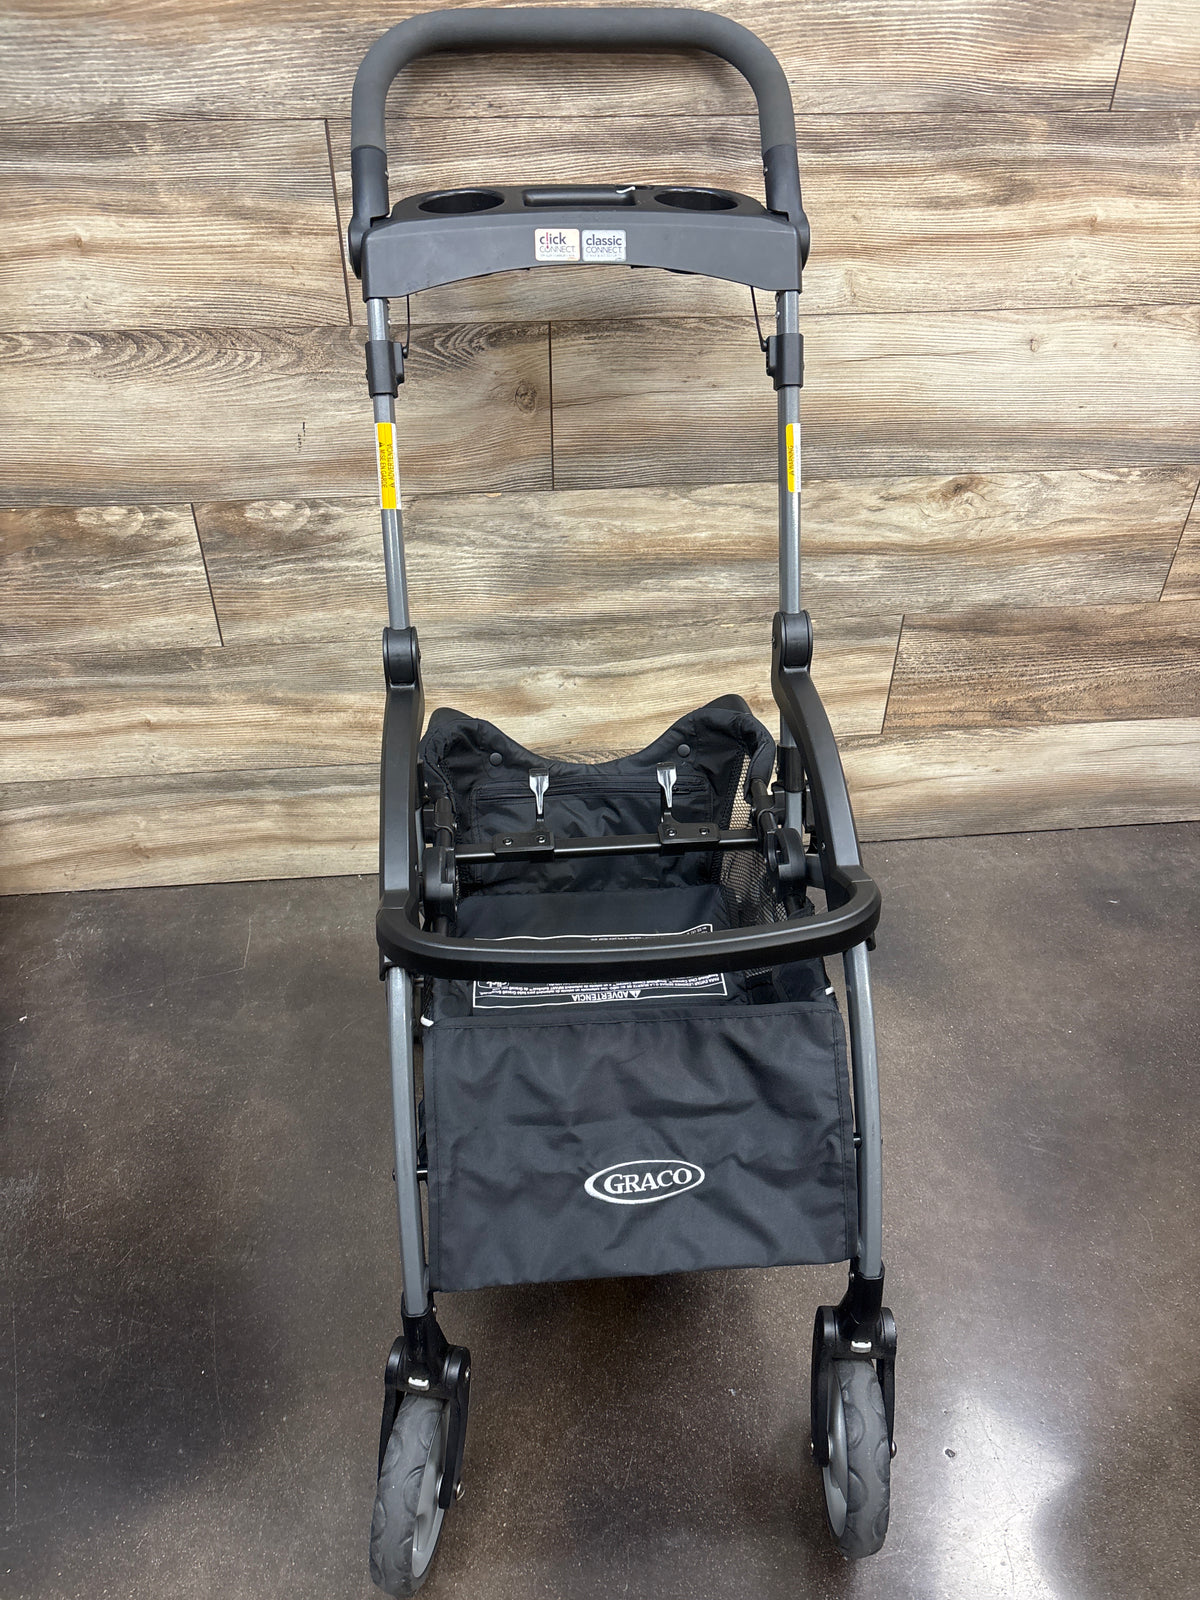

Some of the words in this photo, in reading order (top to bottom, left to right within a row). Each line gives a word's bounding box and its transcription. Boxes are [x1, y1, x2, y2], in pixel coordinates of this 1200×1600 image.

[586, 234, 622, 246] classic
[586, 246, 622, 254] CONNECT
[571, 990, 629, 1002] ADVERTENCIA
[603, 1167, 693, 1195] GRACO
